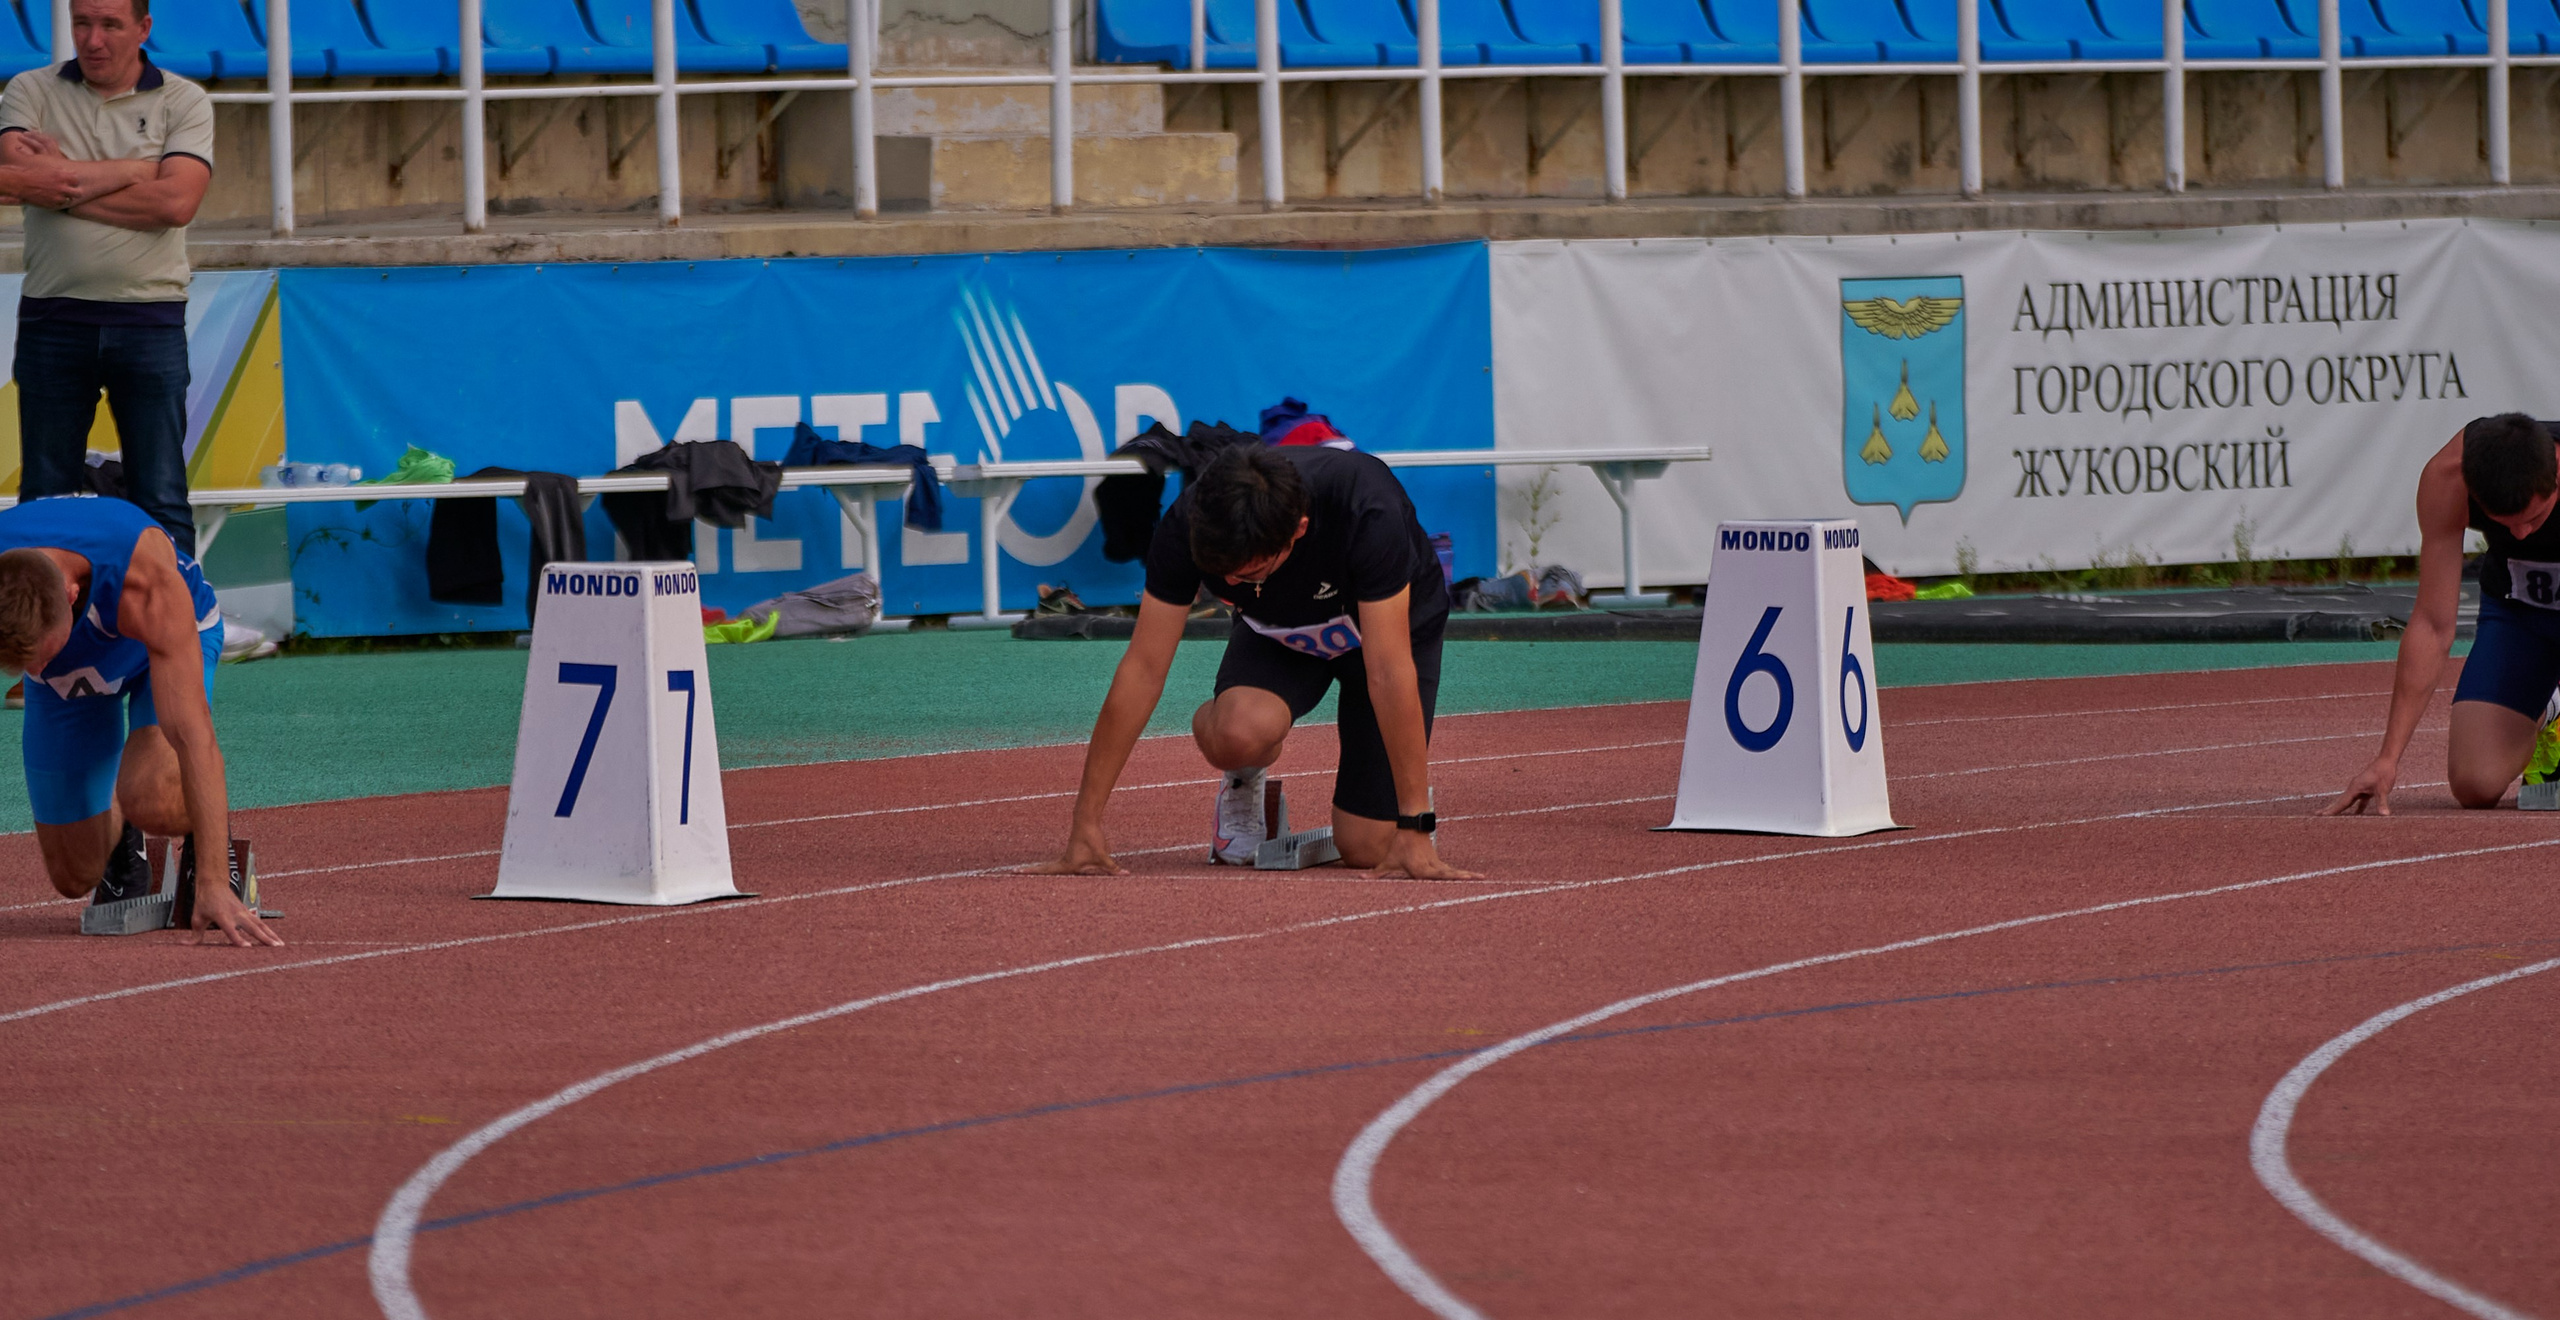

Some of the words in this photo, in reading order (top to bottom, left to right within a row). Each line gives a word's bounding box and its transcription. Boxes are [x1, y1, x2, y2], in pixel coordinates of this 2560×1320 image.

[2011, 273, 2399, 343] АДМИНИСТРАЦИЯ
[2012, 357, 2294, 423] ГОРОДСКОГО
[2306, 352, 2469, 405] ОКРУГА
[2012, 425, 2293, 498] ЖУКОВСКИЙ
[1720, 529, 1811, 553] MONDO
[1823, 527, 1860, 551] MONDO
[546, 572, 640, 598] MONDO
[653, 571, 697, 597] MONDO
[2525, 570, 2560, 605] 8
[1723, 605, 1795, 753] 6
[1839, 605, 1868, 753] 6
[553, 661, 618, 819] 7
[666, 669, 696, 826] 7
